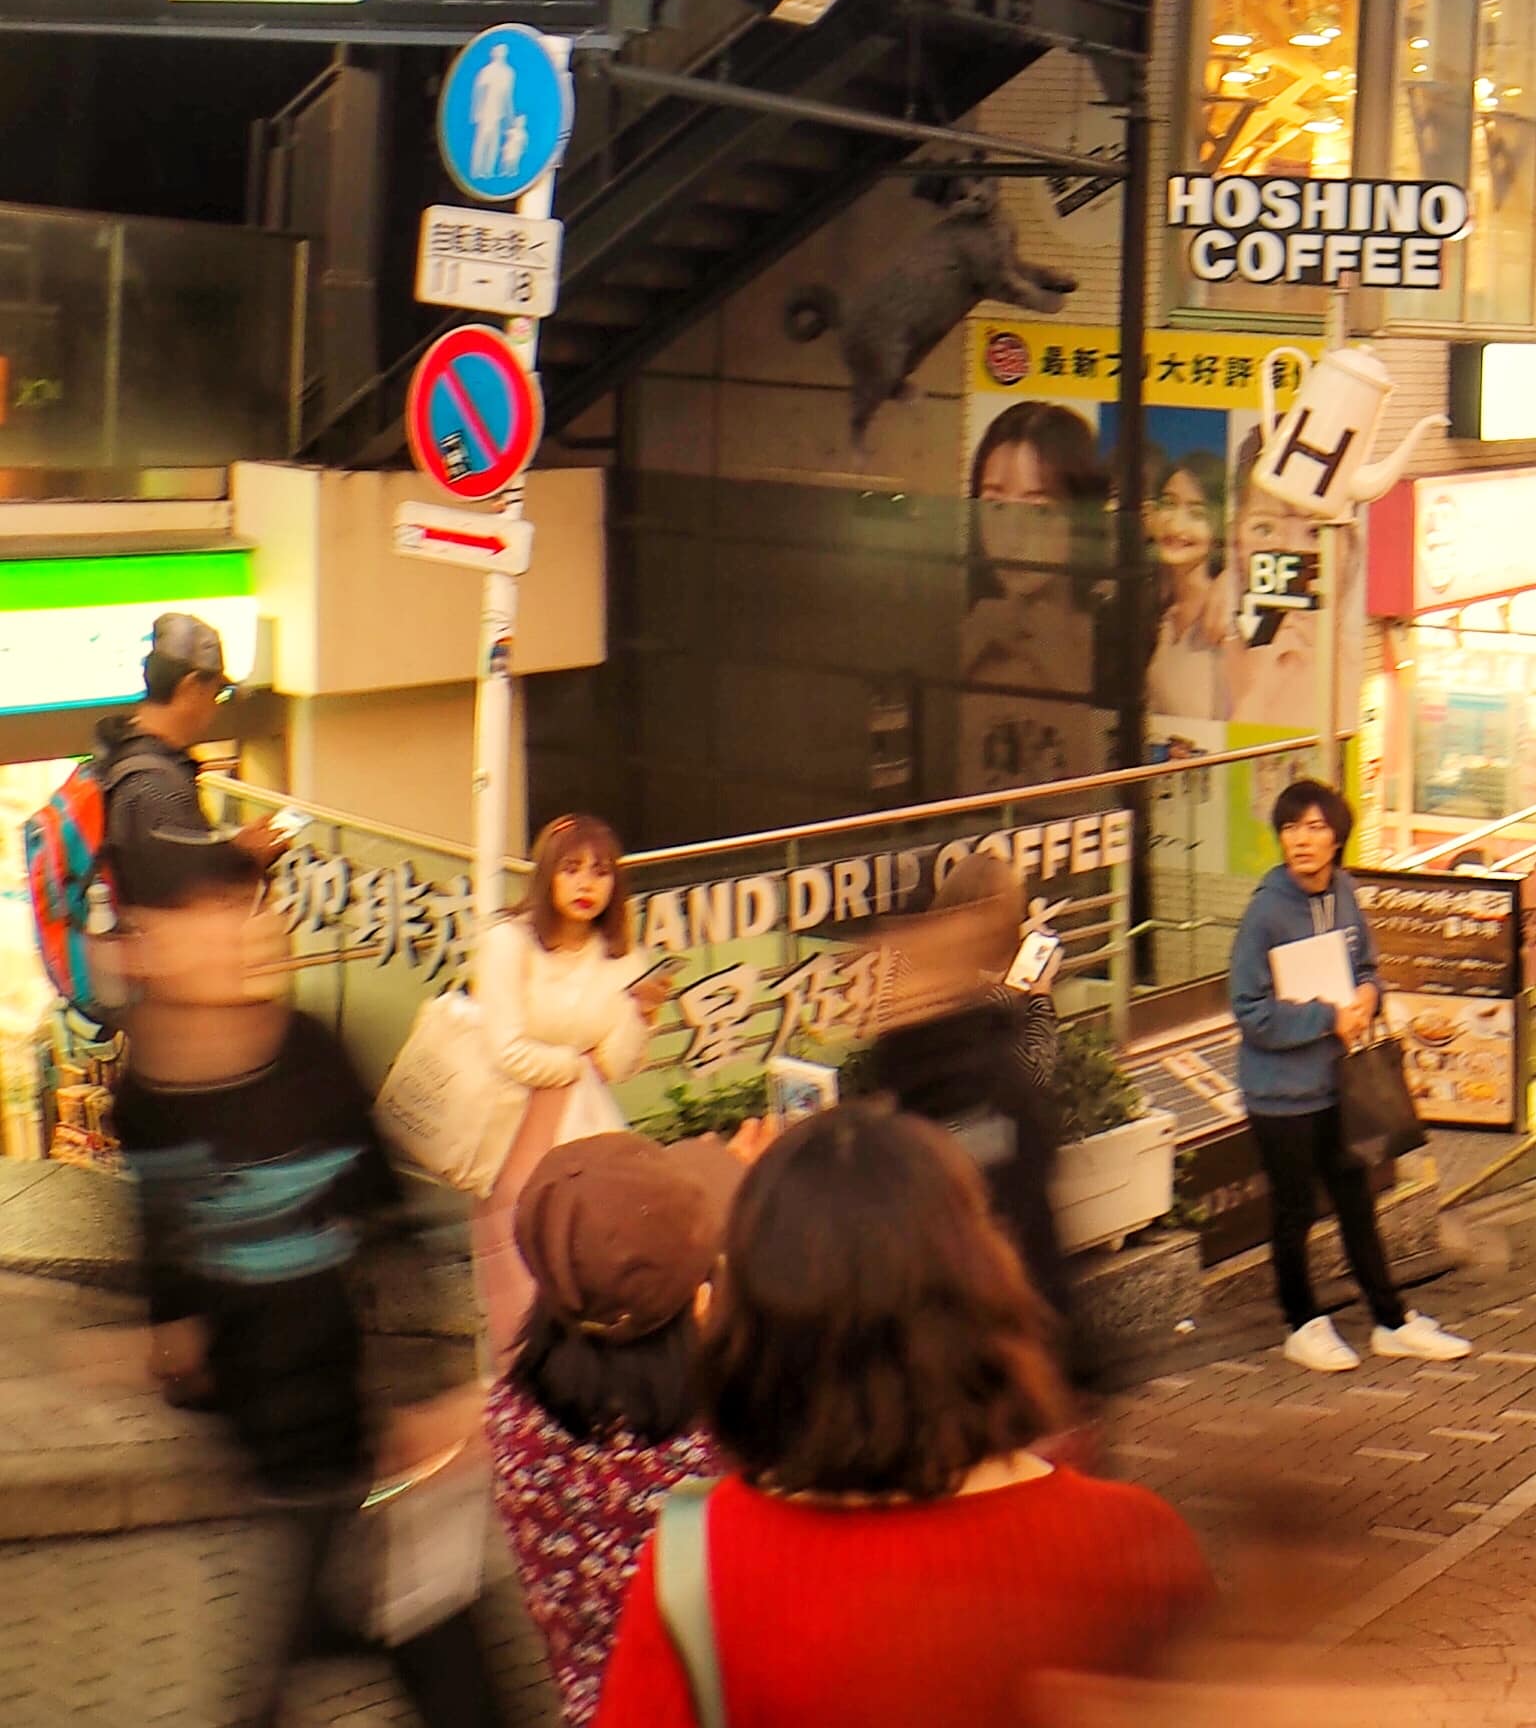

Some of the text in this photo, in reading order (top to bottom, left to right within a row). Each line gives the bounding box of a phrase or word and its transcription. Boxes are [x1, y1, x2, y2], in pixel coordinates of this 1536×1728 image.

[1167, 175, 1467, 236] HOSHINO
[1191, 229, 1442, 287] COFFEE
[1273, 407, 1357, 498] H
[1250, 553, 1301, 594] BF
